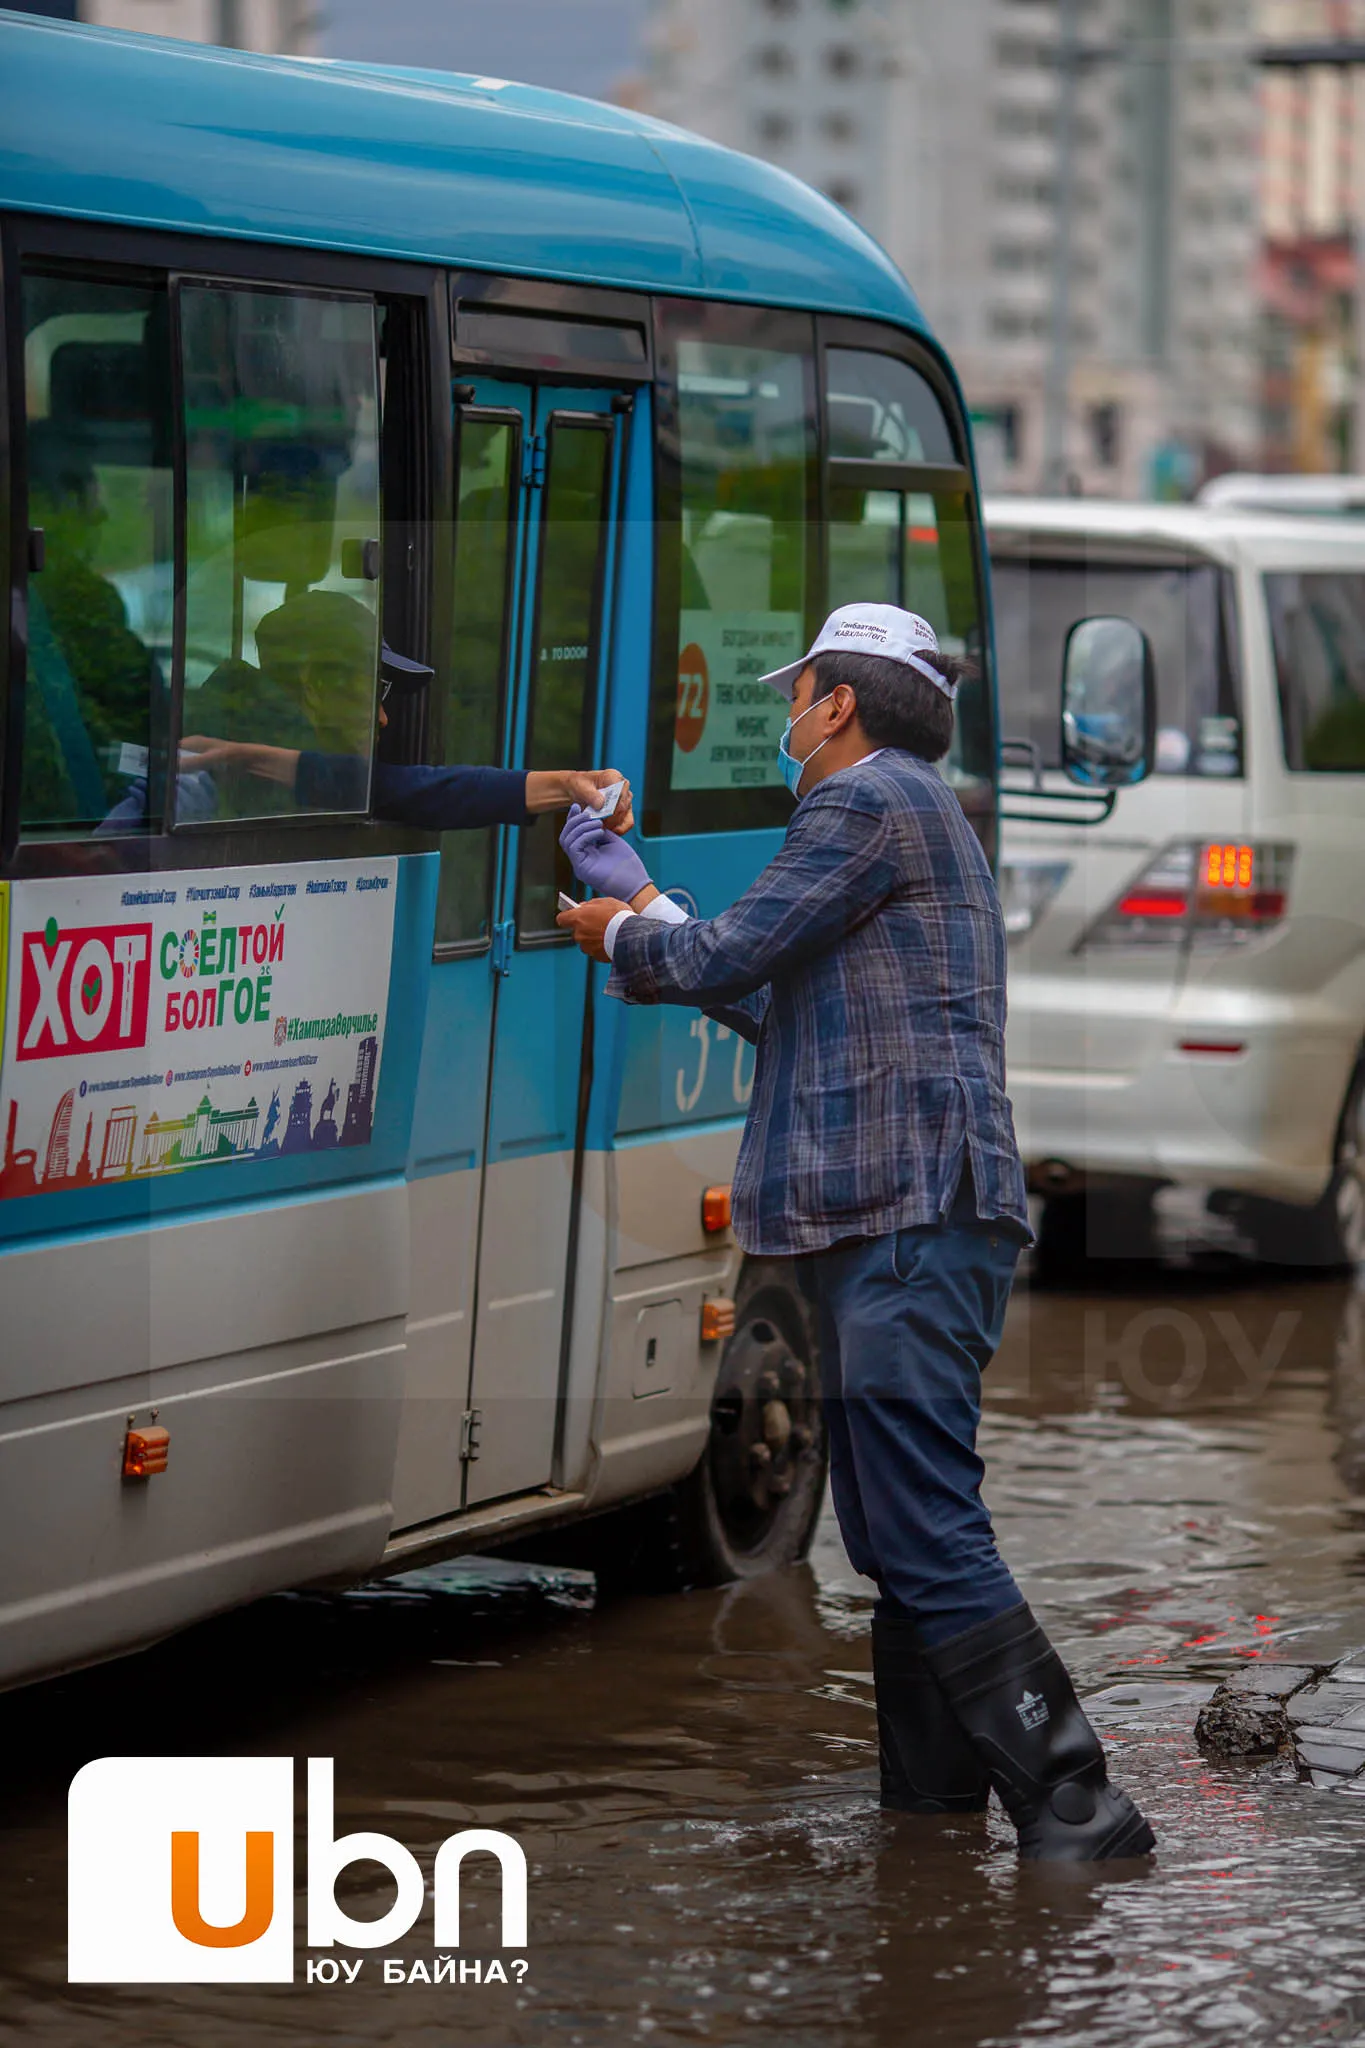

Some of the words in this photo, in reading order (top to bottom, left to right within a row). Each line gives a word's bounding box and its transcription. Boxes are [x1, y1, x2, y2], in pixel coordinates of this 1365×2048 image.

[677, 672, 704, 719] 72
[159, 904, 286, 981] СОЁЛТОЙ
[22, 934, 148, 1050] ХОТ
[164, 965, 273, 1033] БОЛГОЁ
